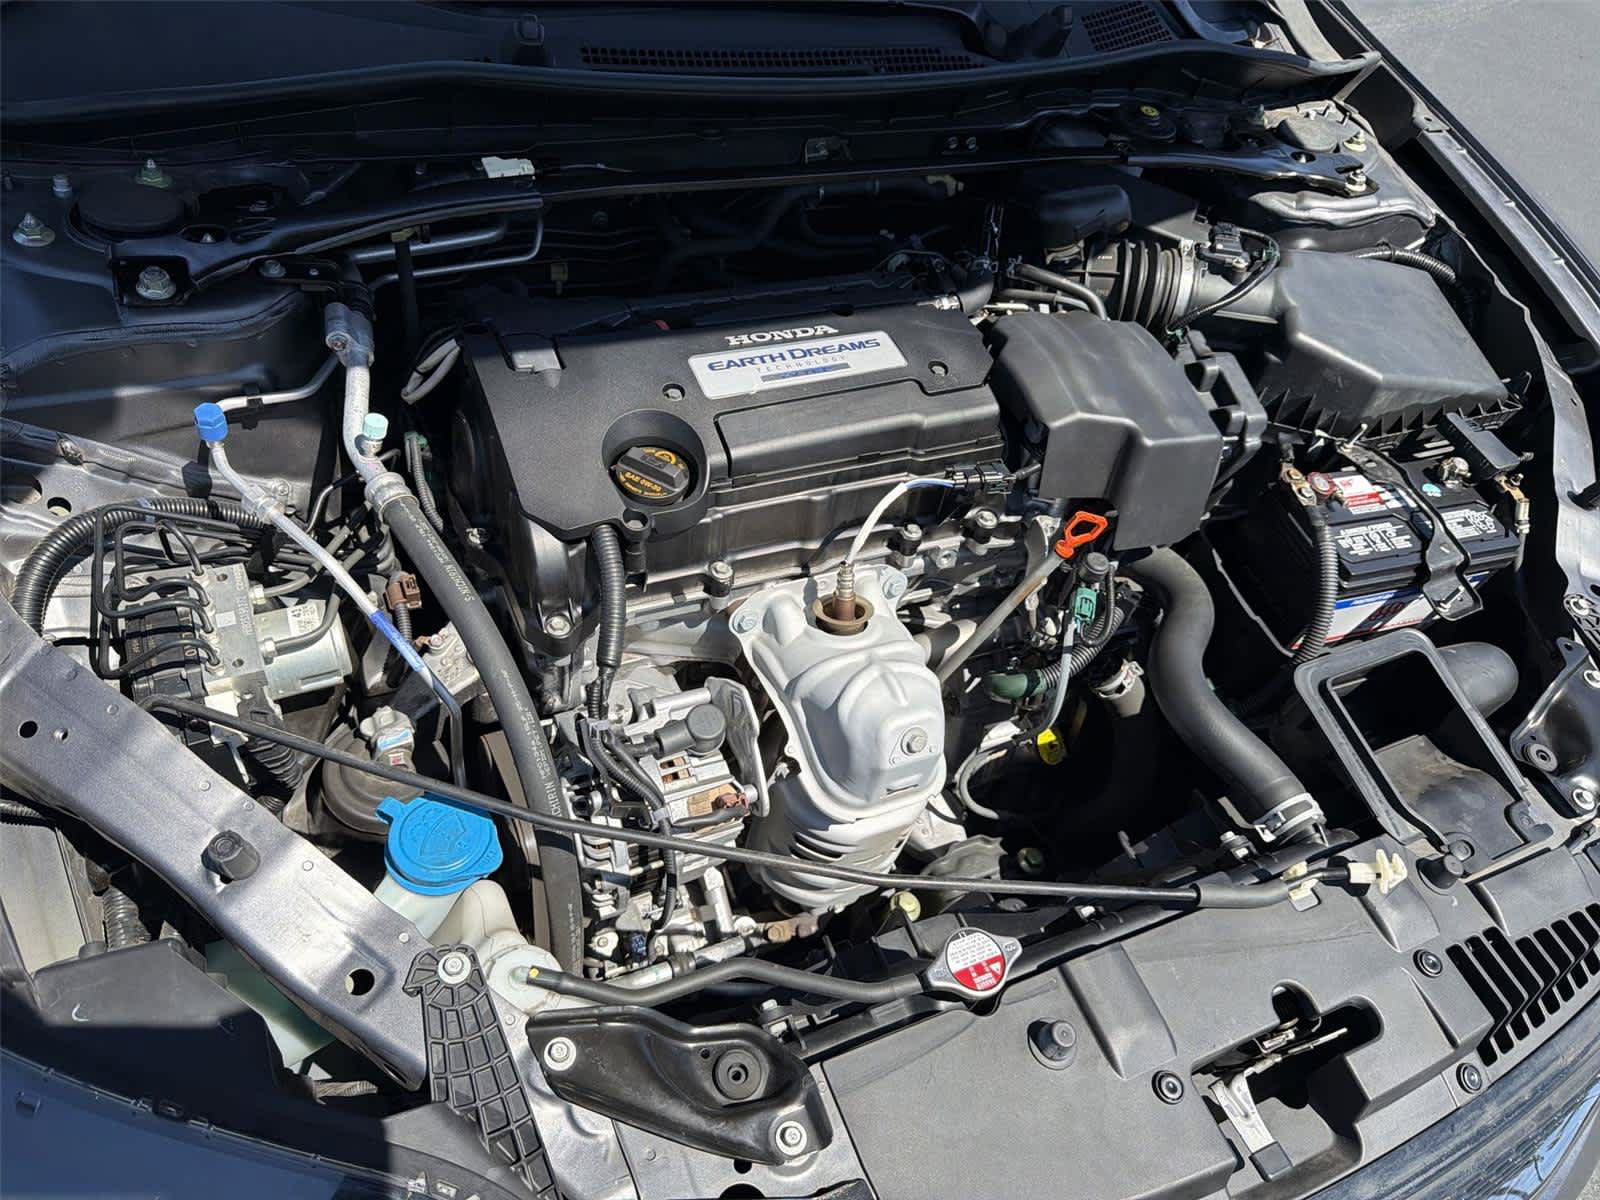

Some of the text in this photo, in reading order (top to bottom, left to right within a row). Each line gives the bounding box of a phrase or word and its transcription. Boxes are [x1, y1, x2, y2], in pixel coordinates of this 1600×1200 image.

[725, 325, 839, 346] HONDA
[707, 338, 881, 372] EARTH DREAMS
[757, 355, 847, 372] TECHNOLOGY
